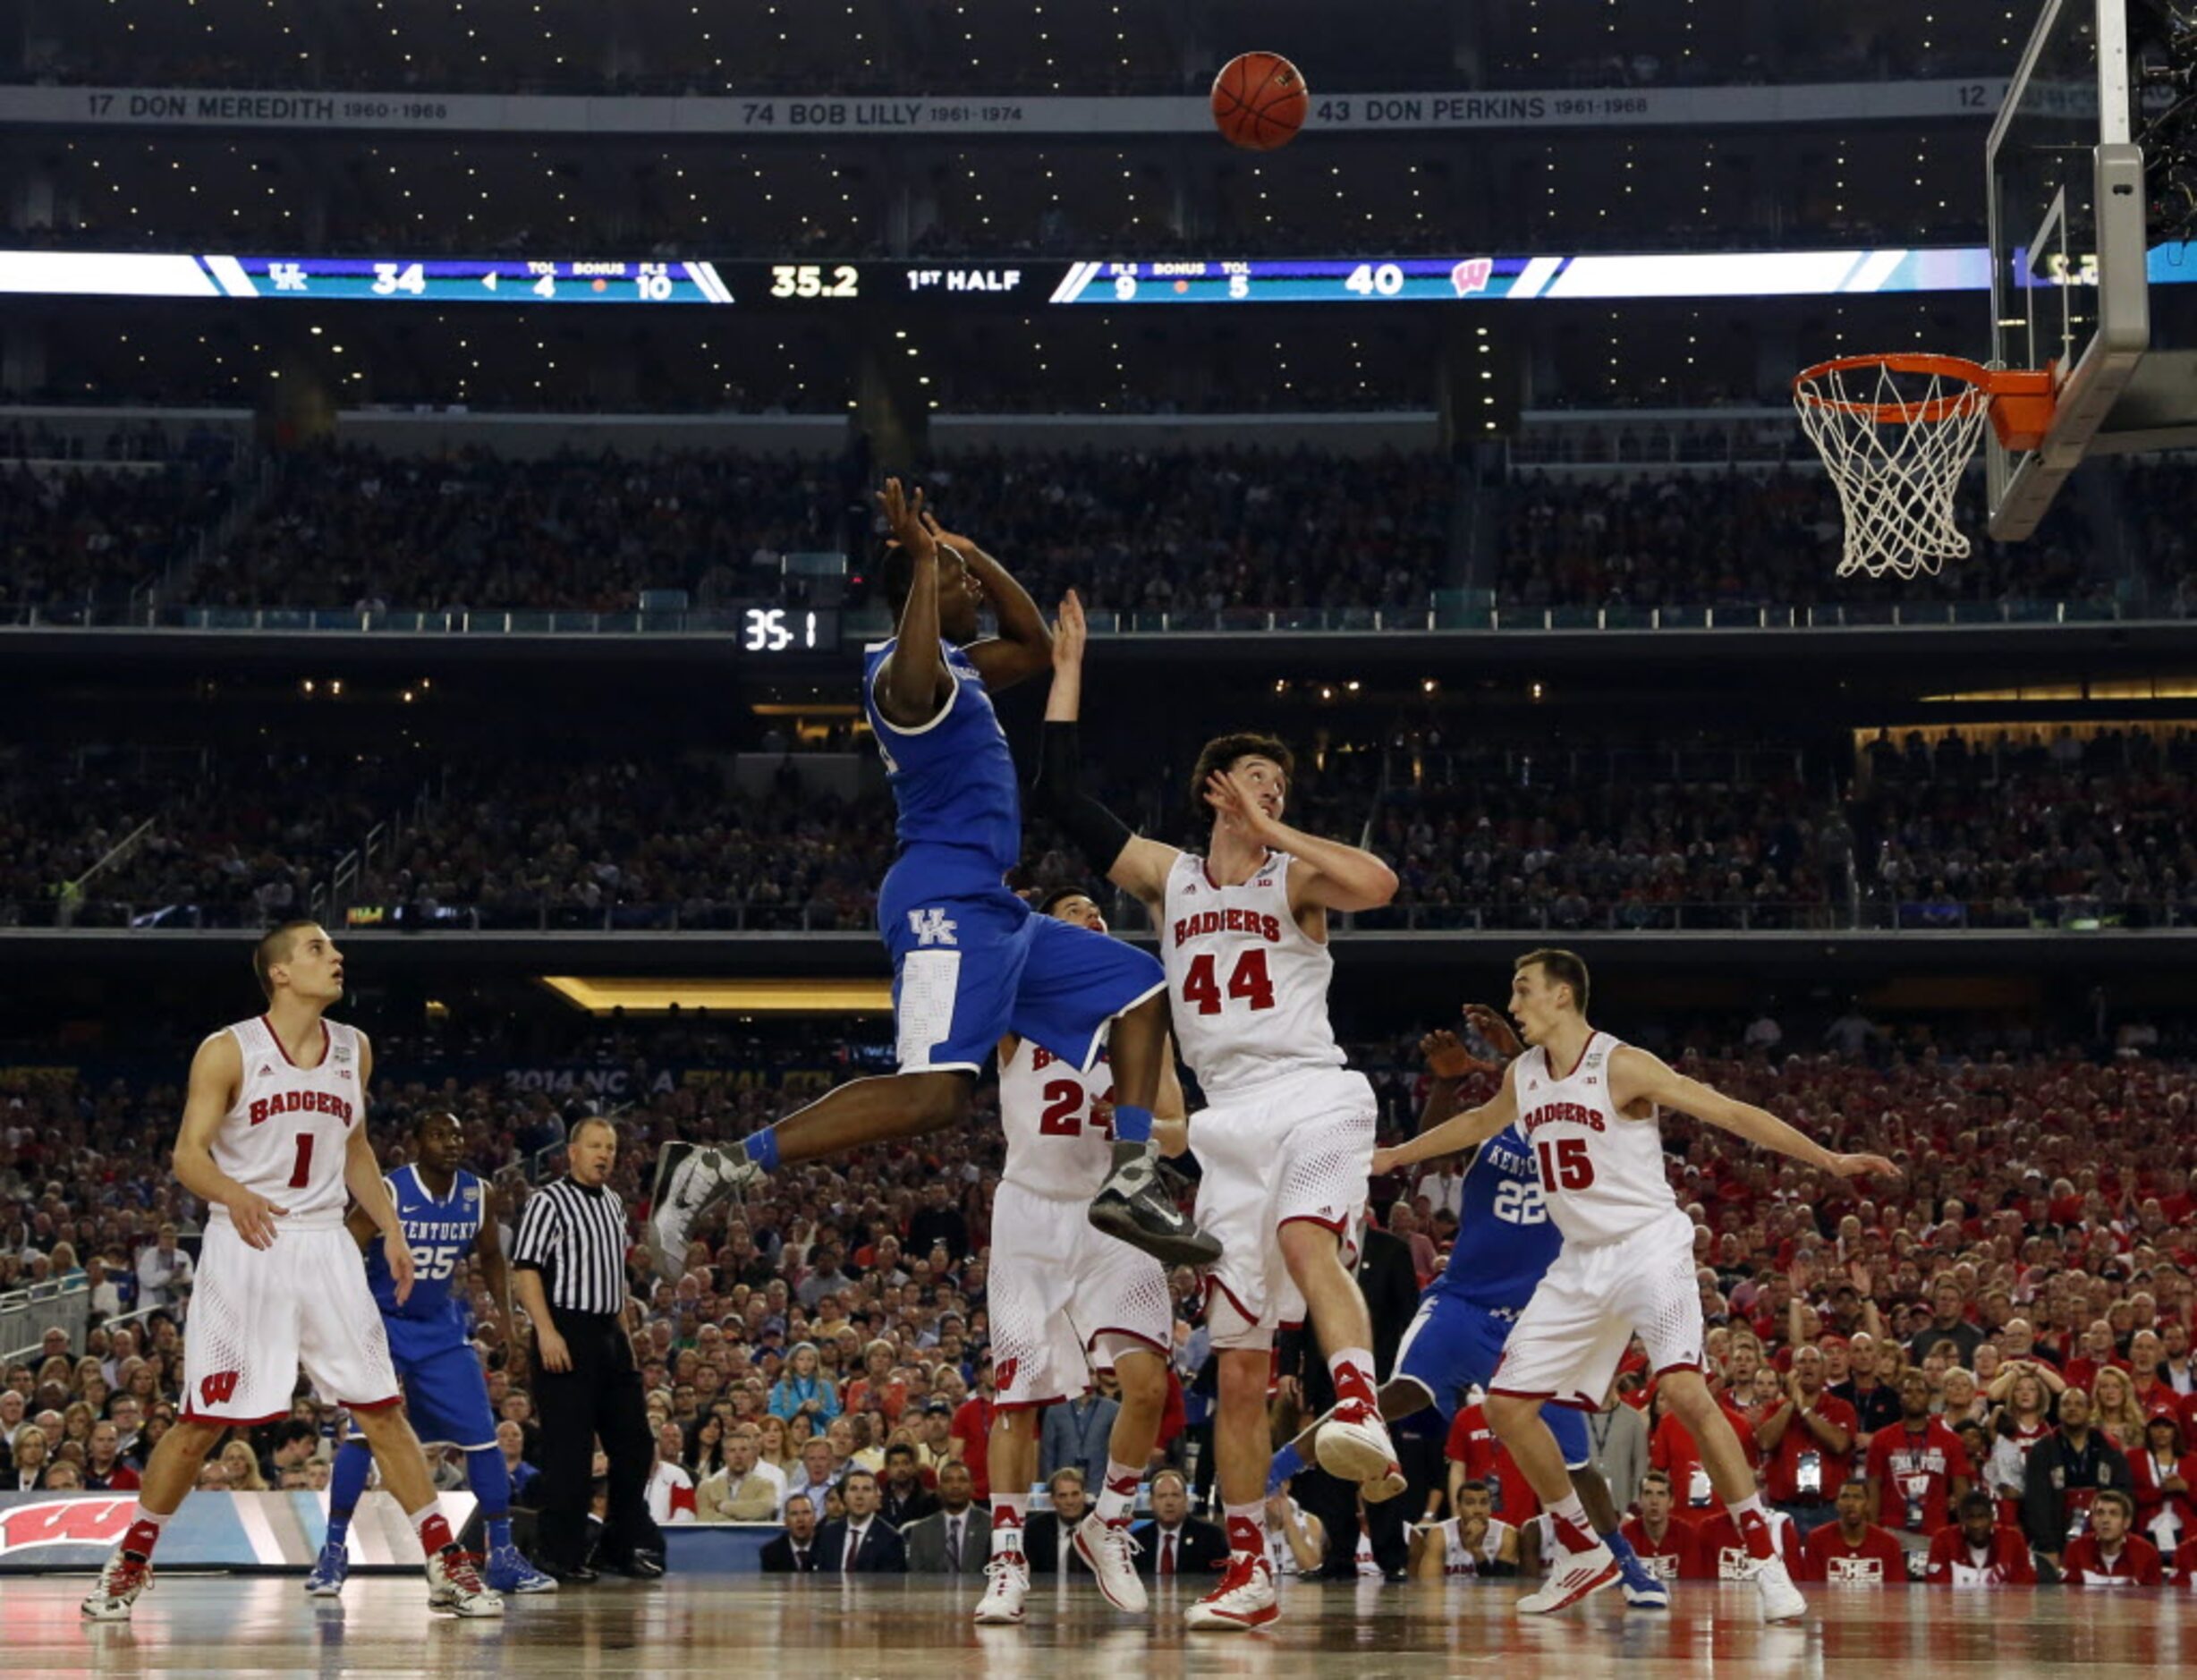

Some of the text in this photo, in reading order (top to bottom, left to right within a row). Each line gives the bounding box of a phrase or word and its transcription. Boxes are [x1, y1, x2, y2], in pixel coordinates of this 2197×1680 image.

[89, 96, 113, 115] 17
[130, 96, 185, 118] DON
[198, 98, 335, 120] MEREDITH
[1960, 86, 1984, 106] 12
[743, 105, 774, 123] 74
[790, 105, 845, 124] BOB
[856, 104, 921, 124] LILLY
[1318, 101, 1350, 121] 43
[1366, 101, 1421, 122] DON
[1433, 98, 1545, 120] PERKINS
[371, 263, 425, 295] 34
[573, 263, 625, 275] BONUS
[770, 266, 858, 297] 35.2
[907, 271, 1020, 291] 1ST HALF
[1152, 263, 1206, 275] BONUS
[1344, 264, 1404, 295] 40
[532, 275, 556, 299] 4
[636, 276, 672, 300] 10
[1115, 276, 1137, 301] 9
[1228, 276, 1250, 299] 5
[907, 908, 957, 946] UK
[1183, 948, 1275, 1014] 44
[505, 1070, 574, 1093] 2014
[250, 1090, 352, 1127] BADGERS
[287, 1133, 314, 1188] 1
[1538, 1139, 1595, 1192] 15
[1493, 1179, 1548, 1225] 22
[411, 1246, 460, 1280] 25
[200, 1370, 239, 1408] W
